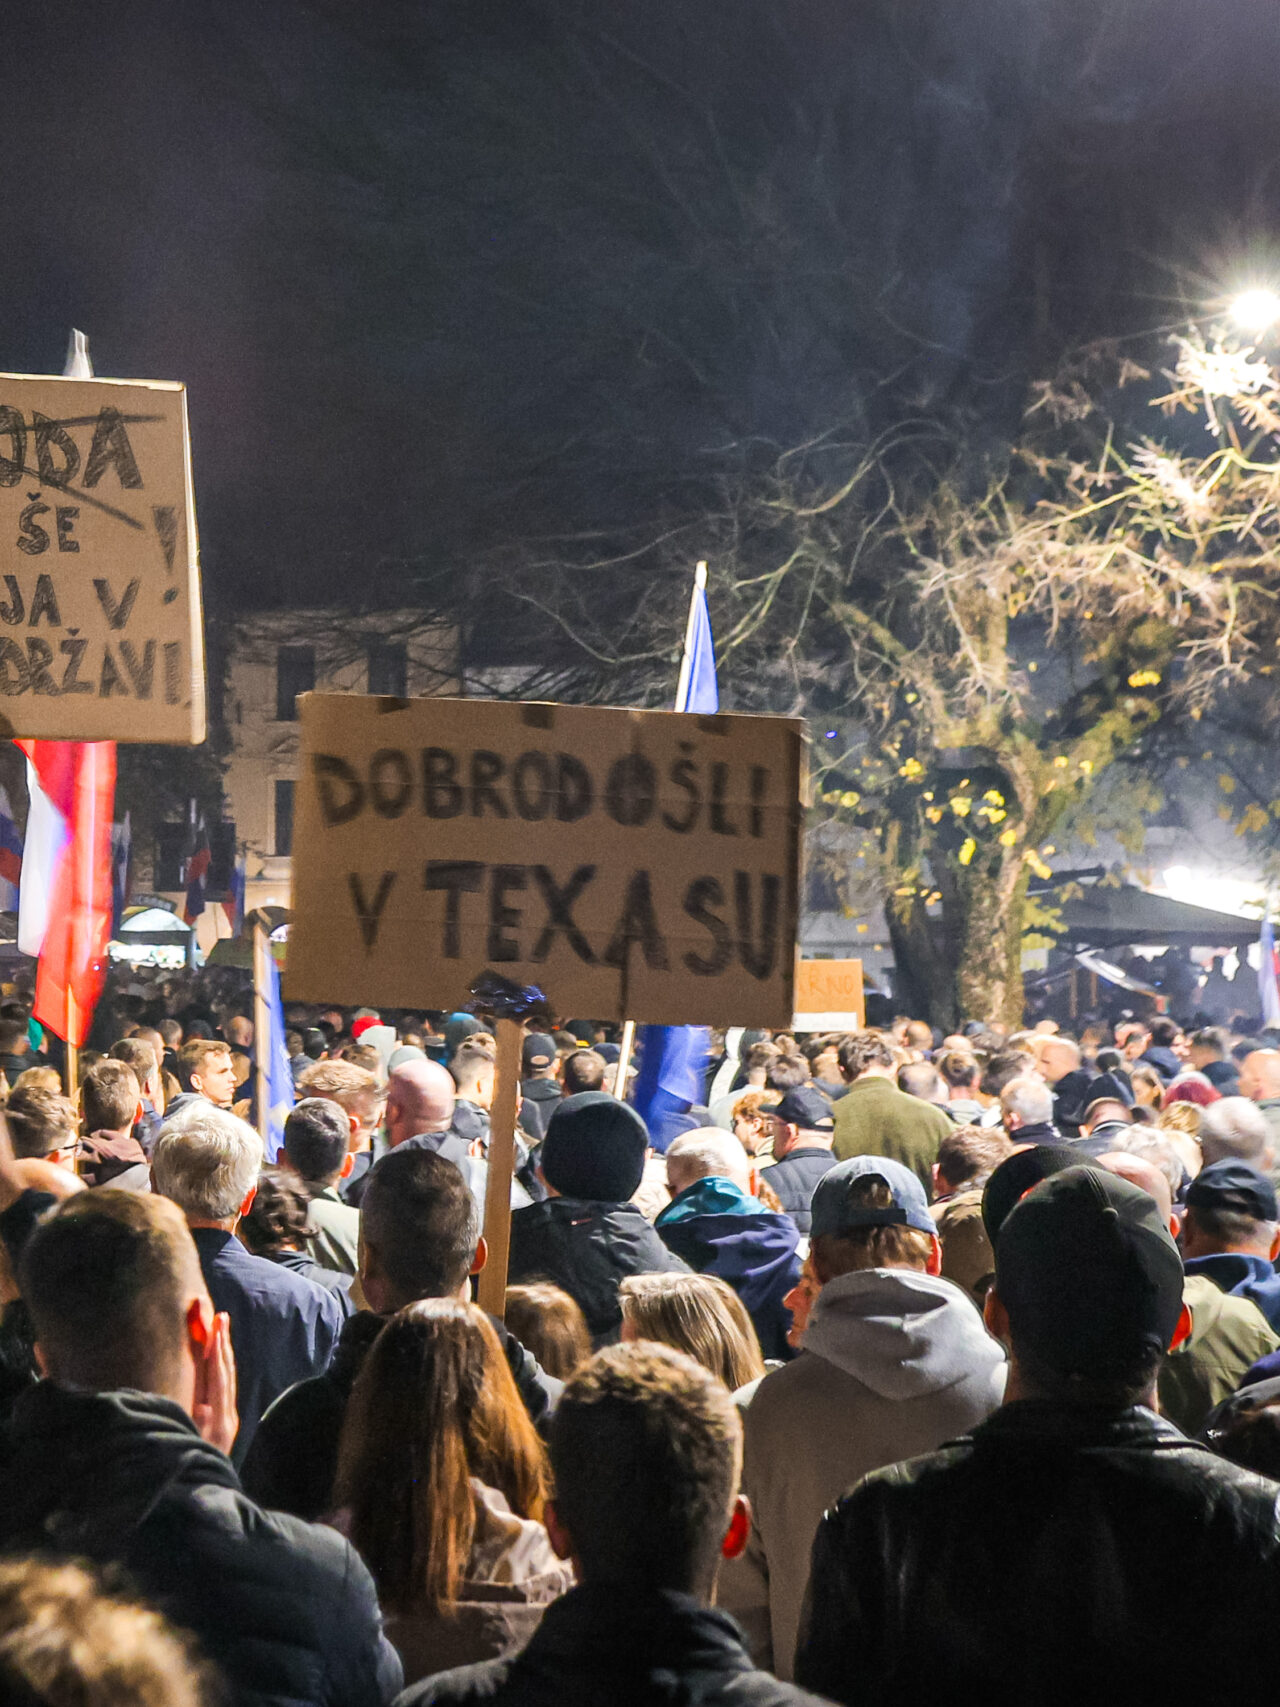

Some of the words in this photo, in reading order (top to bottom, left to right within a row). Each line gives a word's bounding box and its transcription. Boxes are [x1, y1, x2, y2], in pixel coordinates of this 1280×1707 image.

[16, 491, 81, 555] ŠE
[92, 577, 140, 631] V
[313, 741, 770, 839] DOBRODOŠLI
[348, 871, 397, 957] V
[423, 859, 783, 981] TEXASU
